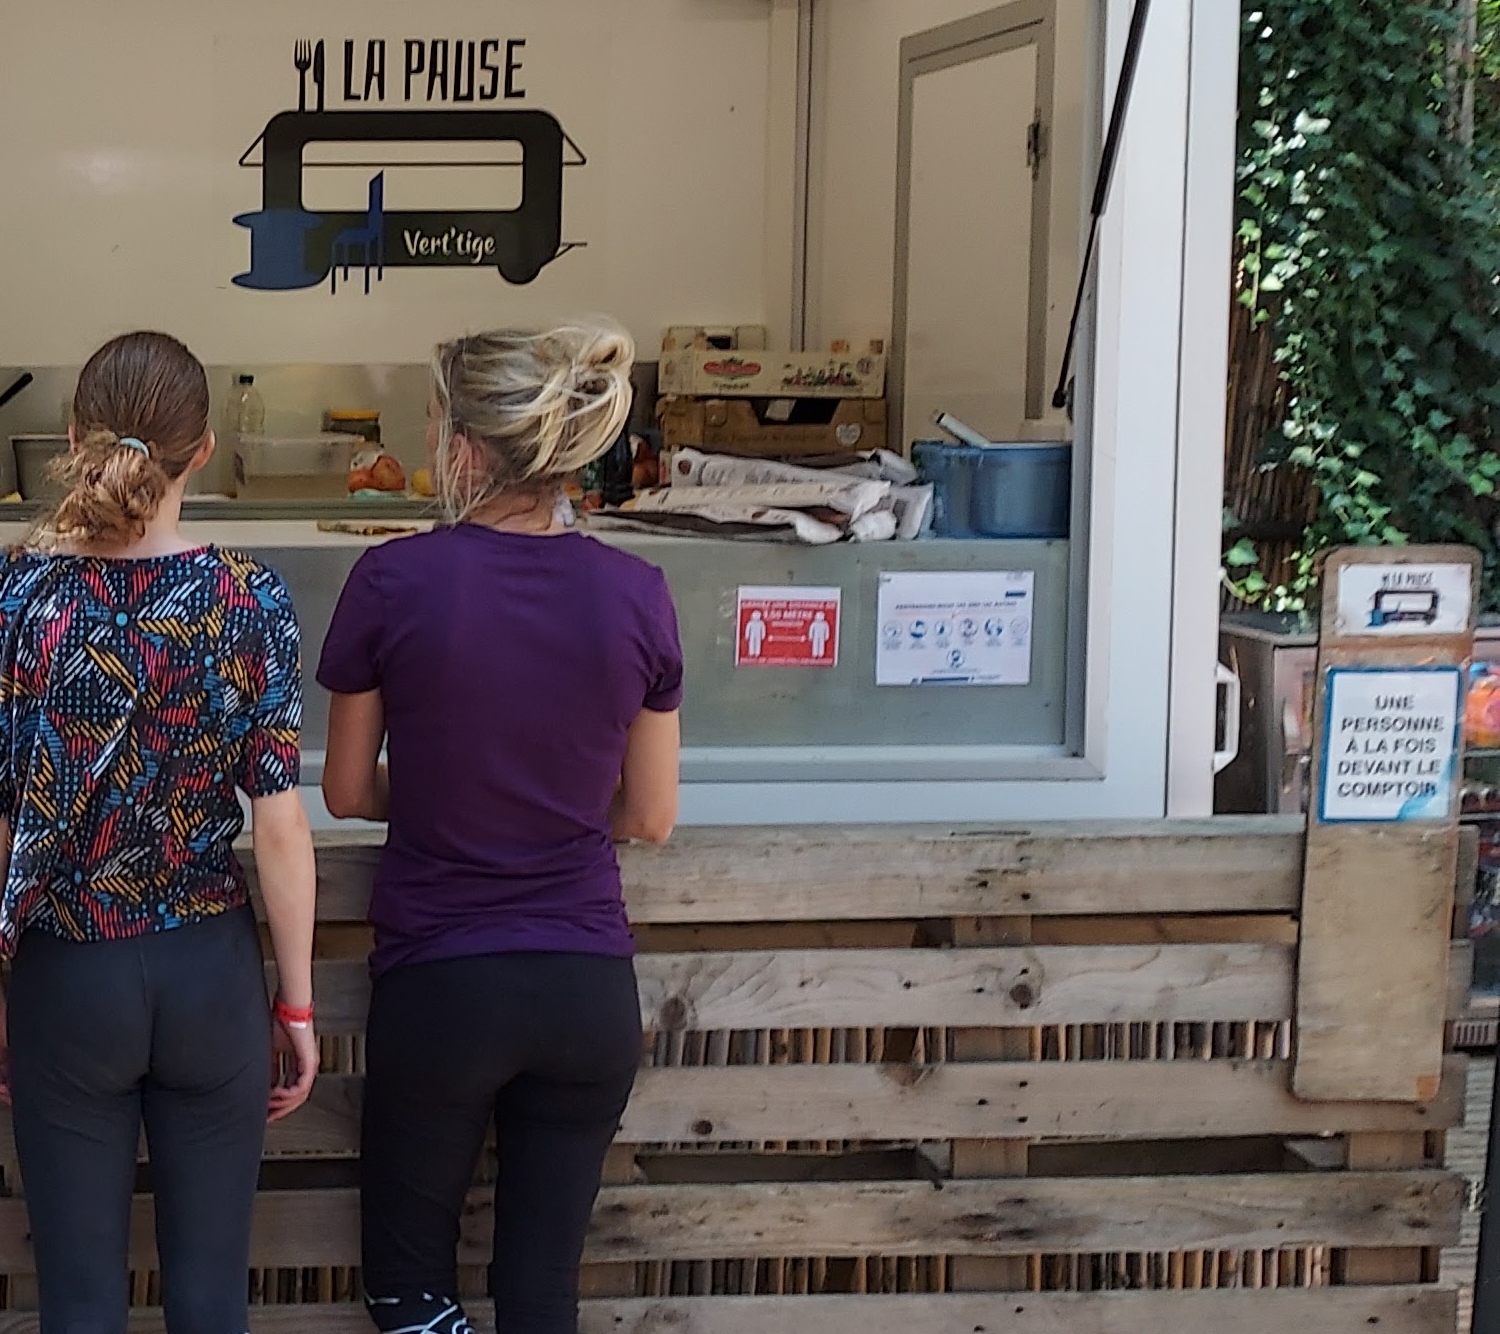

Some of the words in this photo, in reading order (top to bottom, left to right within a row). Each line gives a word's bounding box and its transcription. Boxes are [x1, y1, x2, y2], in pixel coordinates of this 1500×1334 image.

[343, 38, 386, 102] LA
[403, 37, 527, 104] PAUSE
[403, 226, 497, 265] Vert'tige
[1374, 695, 1415, 711] UNE
[1340, 715, 1445, 733] PERSONNE
[1363, 738, 1388, 754] LA
[1392, 737, 1438, 754] FOIS
[1337, 758, 1412, 776] DEVANT
[1415, 758, 1442, 775] LE
[1337, 780, 1437, 798] COMPTOIR
